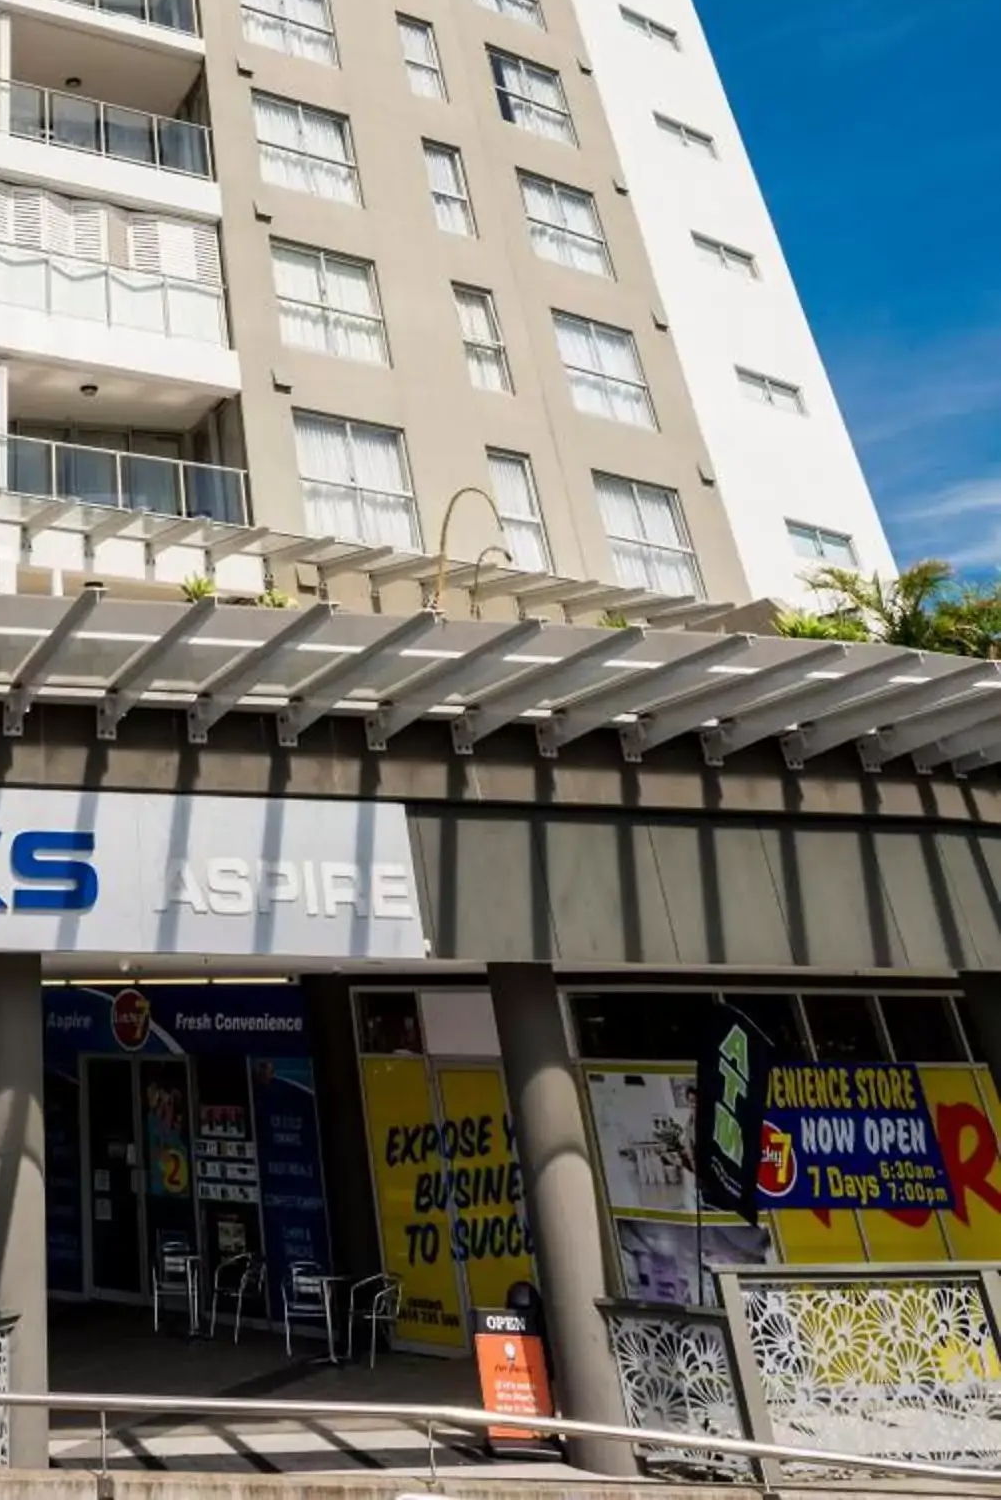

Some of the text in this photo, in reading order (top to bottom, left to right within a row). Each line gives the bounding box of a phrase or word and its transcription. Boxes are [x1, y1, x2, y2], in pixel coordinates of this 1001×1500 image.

[153, 857, 414, 919] ASPIRE
[47, 1011, 93, 1032] Aspire
[175, 1011, 303, 1033] Fresh Convenience
[713, 1024, 749, 1169] ATM
[854, 1067, 917, 1110] STORE
[385, 1114, 493, 1167] EXPOSE
[800, 1115, 927, 1155] NOW OPEN
[167, 1152, 181, 1186] 2
[807, 1165, 881, 1205] 7 Days
[887, 1183, 948, 1206] 7:00pm
[405, 1222, 440, 1268] TO
[485, 1315, 526, 1332] OPEN
